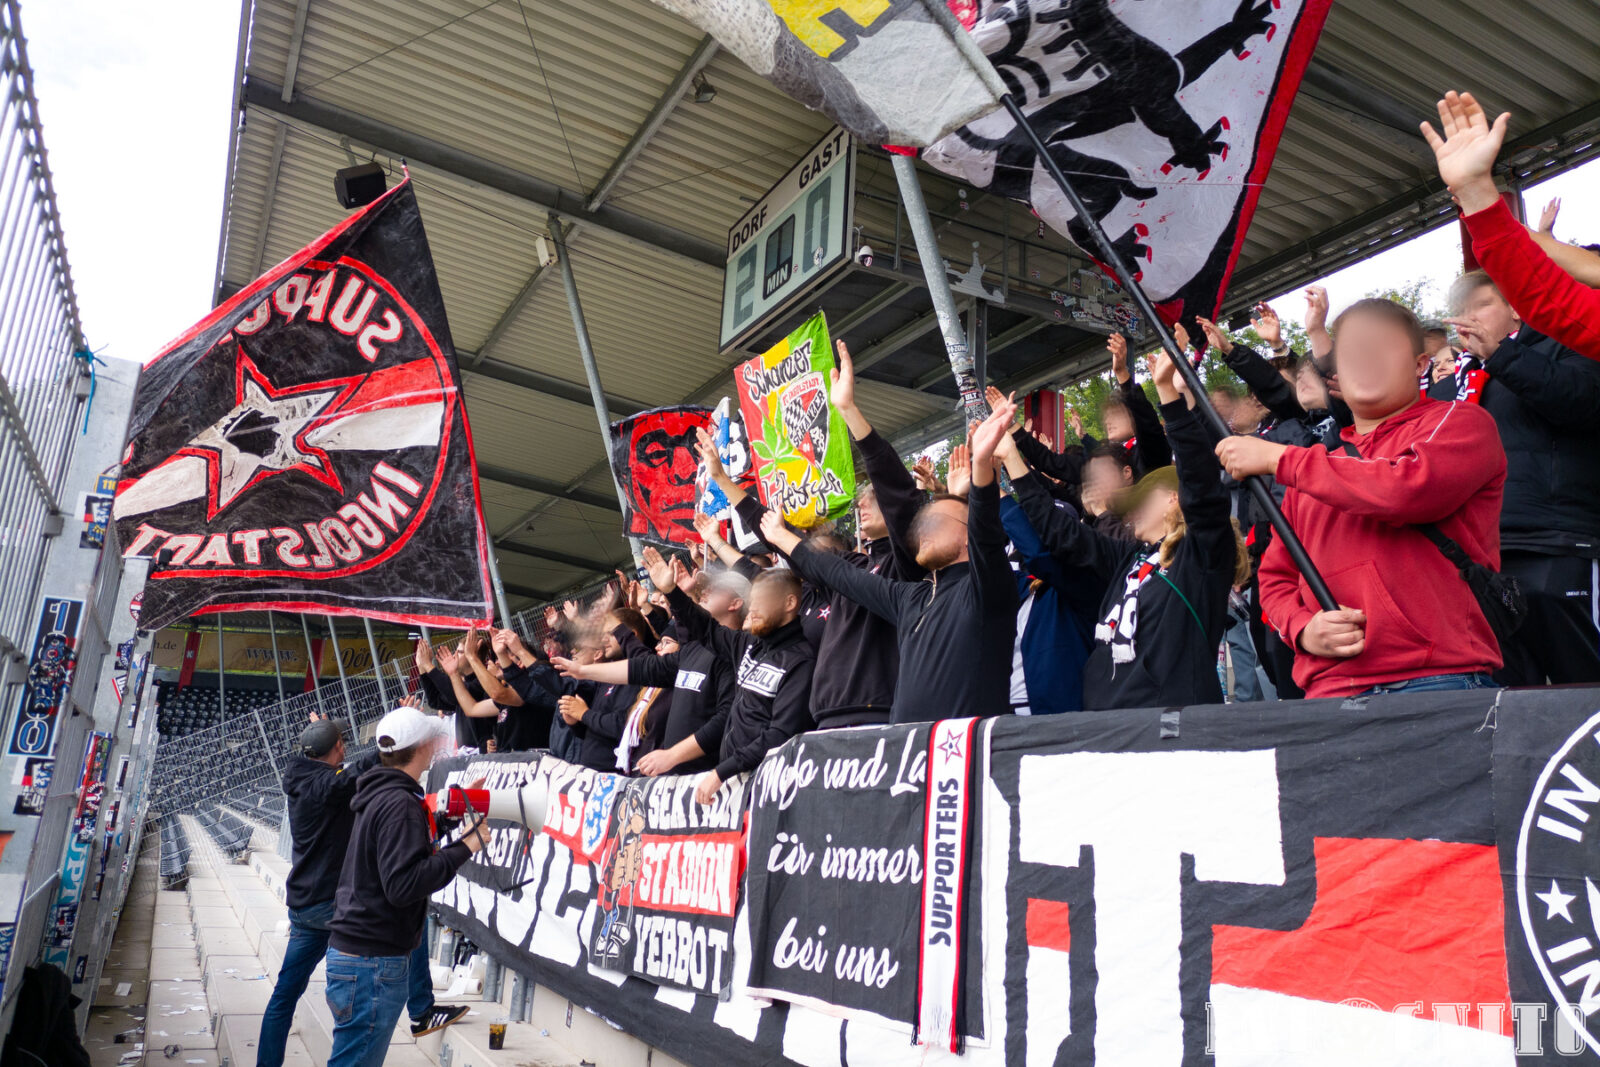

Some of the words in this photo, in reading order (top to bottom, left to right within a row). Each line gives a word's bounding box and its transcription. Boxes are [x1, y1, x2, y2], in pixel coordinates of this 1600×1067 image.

[799, 130, 845, 189] GAST
[732, 204, 768, 254] DORF
[766, 263, 790, 296] MIN
[743, 339, 812, 402] Schanzer
[824, 738, 888, 789] und
[639, 841, 734, 914] STADION
[821, 833, 924, 884] immer
[929, 778, 959, 947] SUPPORTERS
[633, 914, 729, 994] VERBOT
[773, 917, 828, 973] bei
[835, 944, 899, 989] uns
